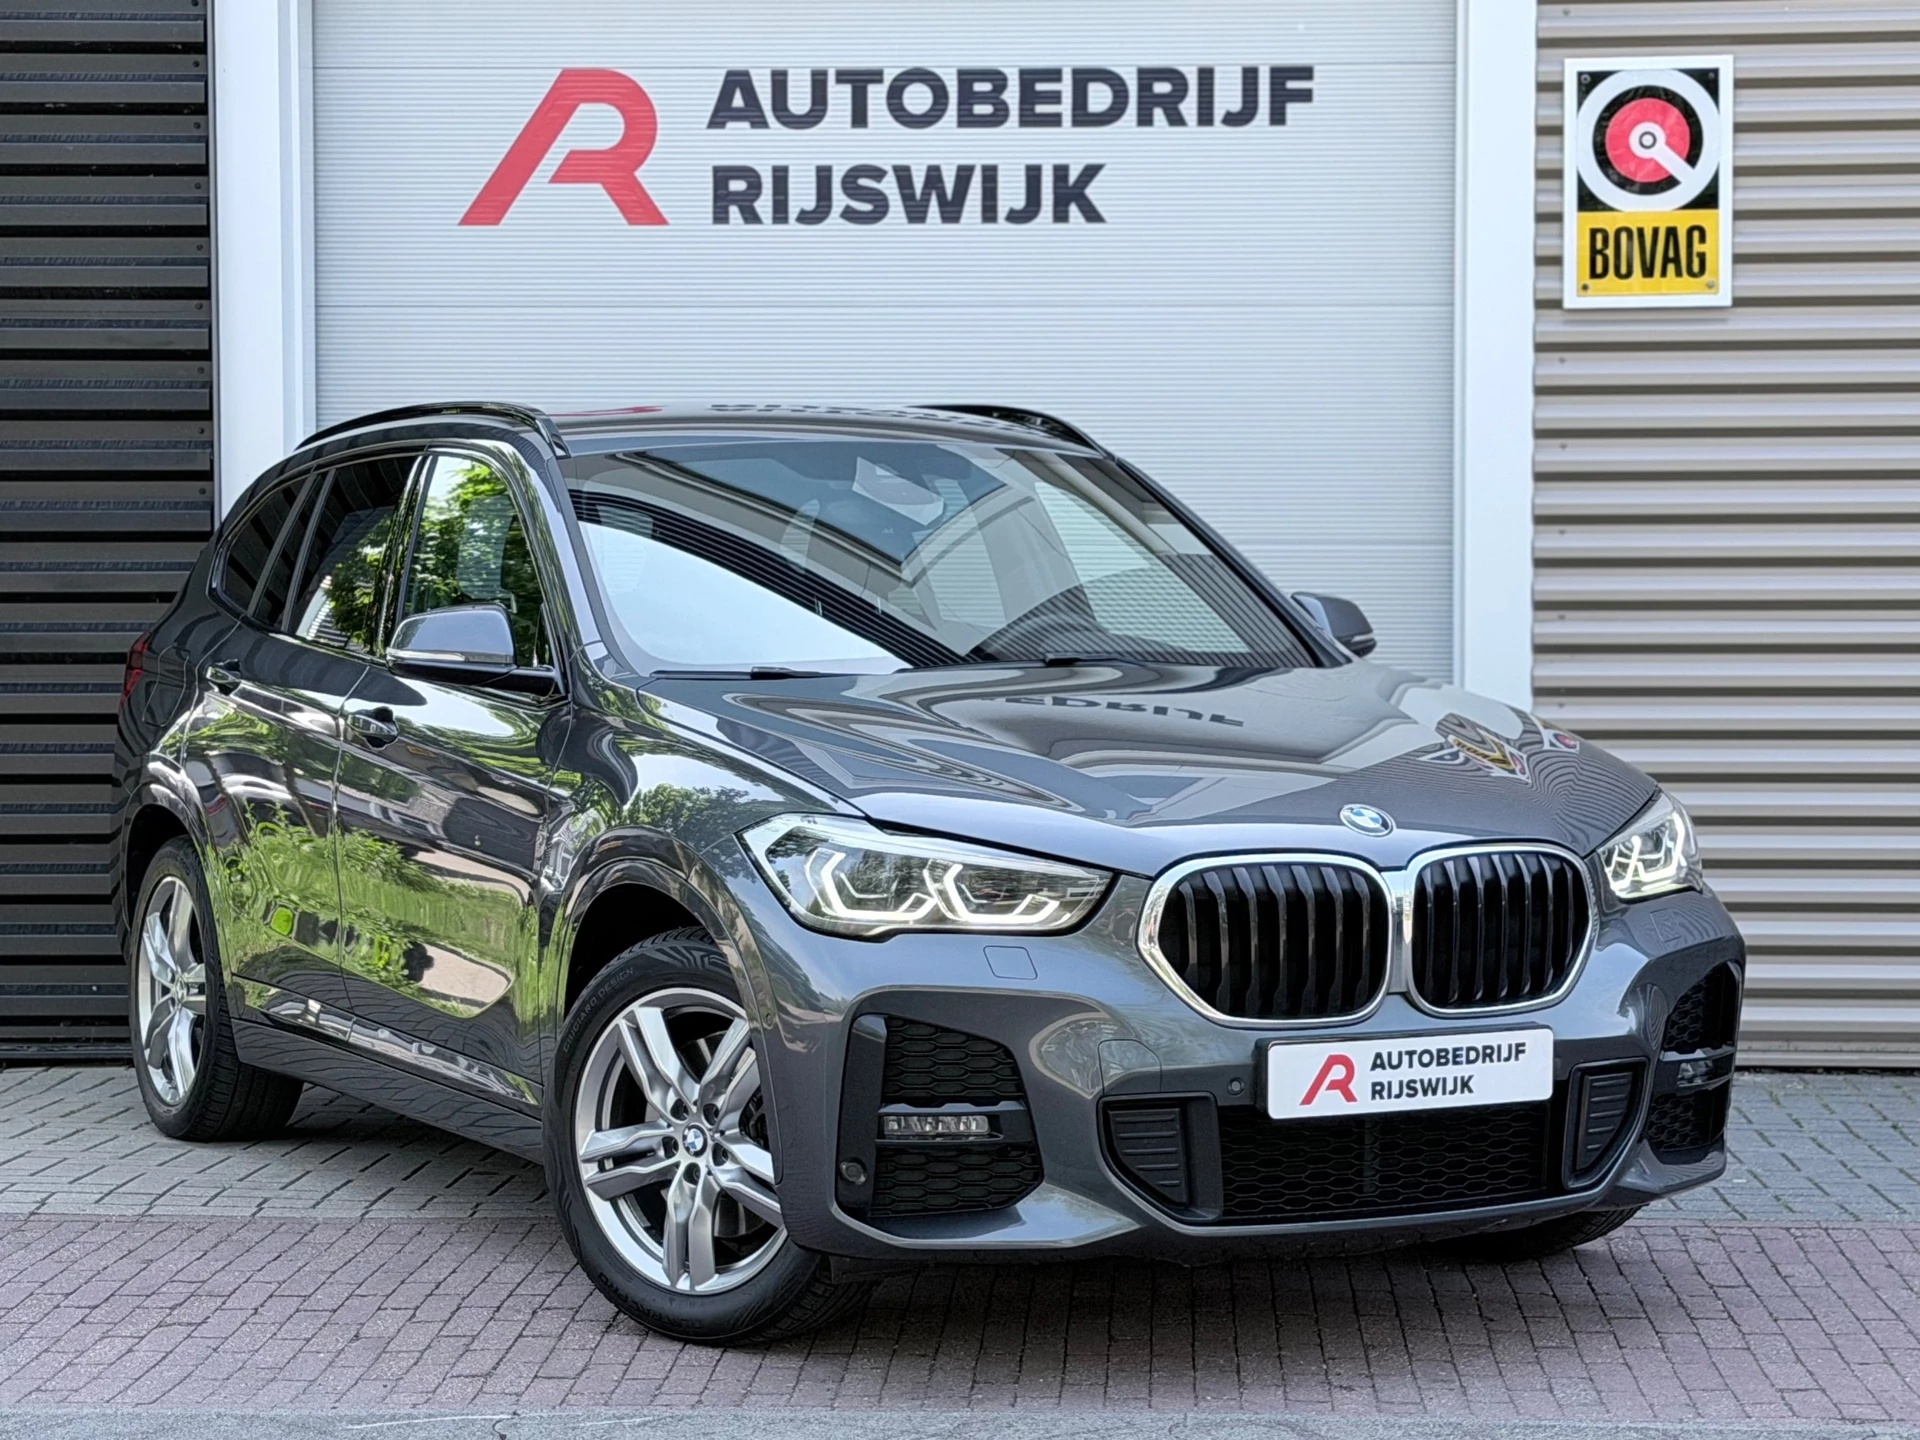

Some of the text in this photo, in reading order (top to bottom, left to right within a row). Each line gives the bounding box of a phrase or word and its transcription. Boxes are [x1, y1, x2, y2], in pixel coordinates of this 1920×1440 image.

[706, 65, 1315, 130] AUTOBEDRIJF
[711, 163, 1107, 226] RIJSWIJK
[1588, 224, 1707, 280] BOVAG
[1369, 1041, 1527, 1072] AUTOBEDRIJF
[1370, 1074, 1475, 1101] RIJSWIJK
